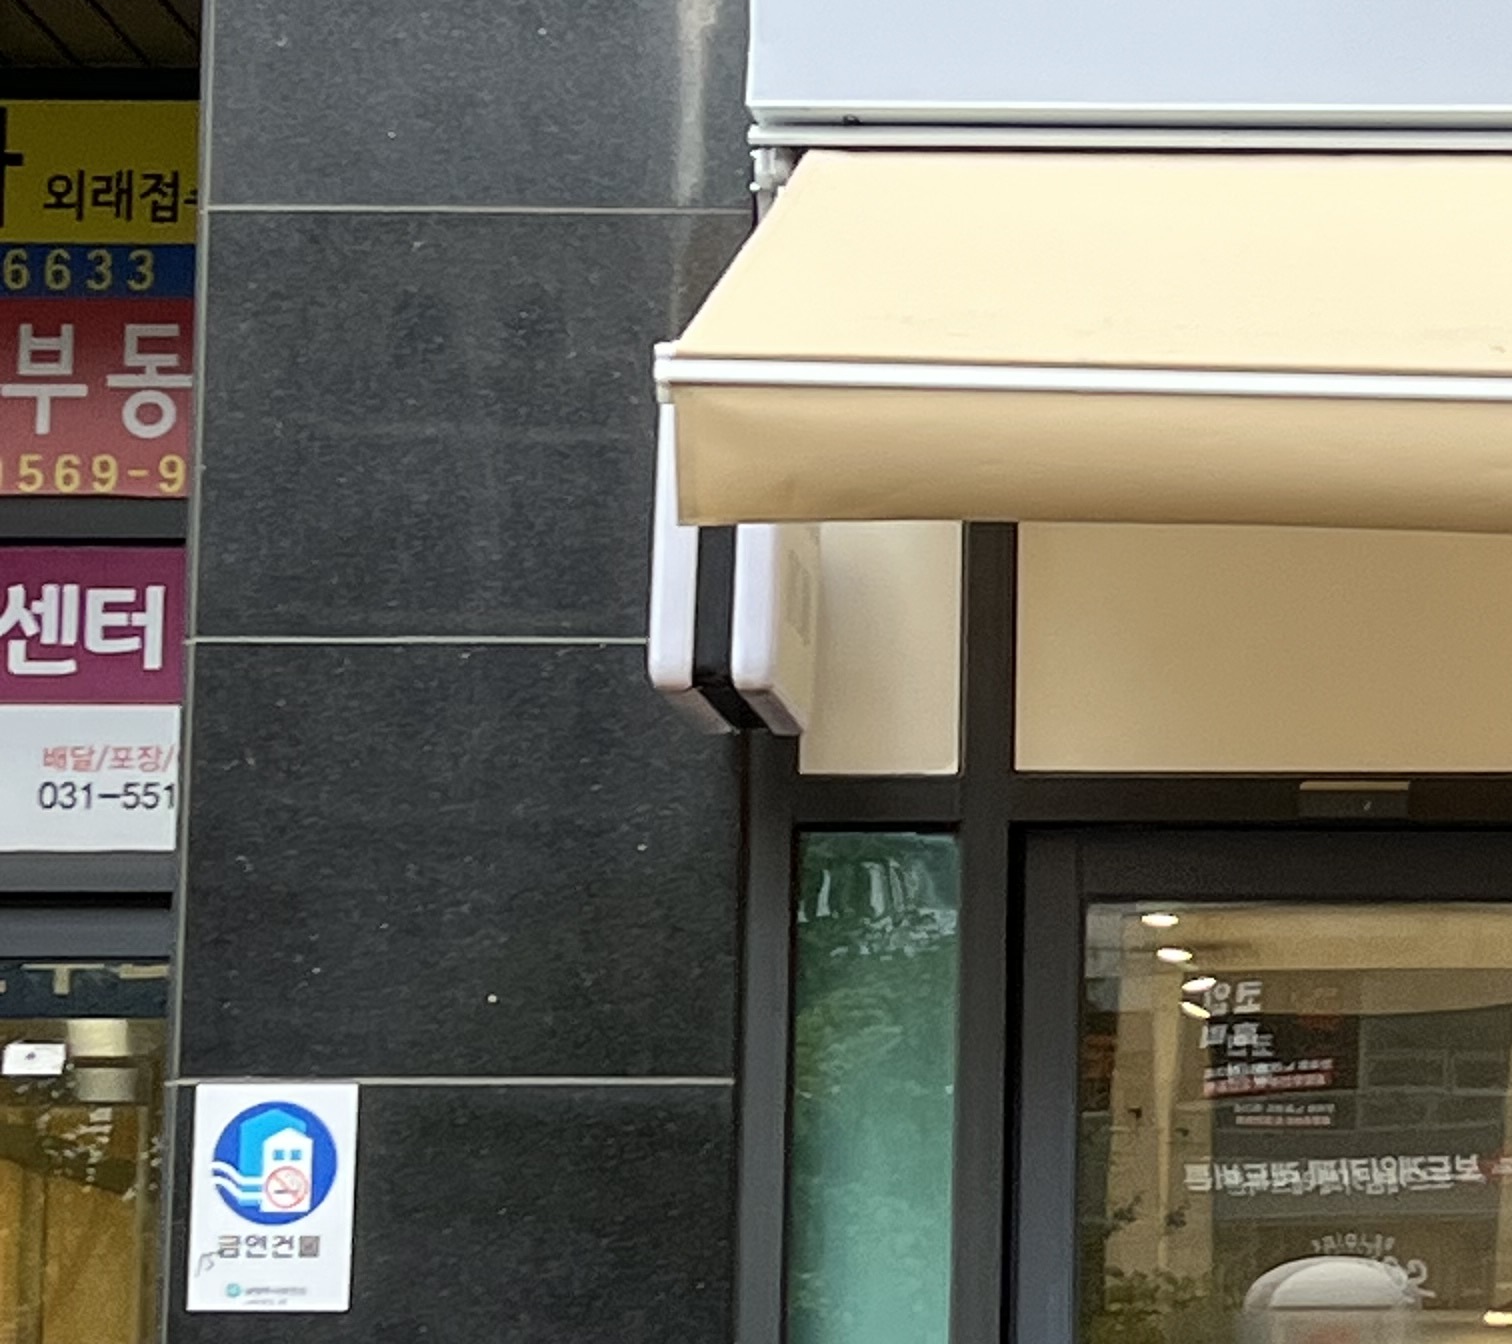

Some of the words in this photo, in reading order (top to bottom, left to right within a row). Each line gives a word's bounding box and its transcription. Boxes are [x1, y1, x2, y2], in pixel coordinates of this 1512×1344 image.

[43, 169, 198, 223] 외래접
[3, 248, 155, 292] 6633
[0, 323, 193, 439] 부동
[0, 453, 187, 494] 569-9
[0, 583, 166, 675] 센터
